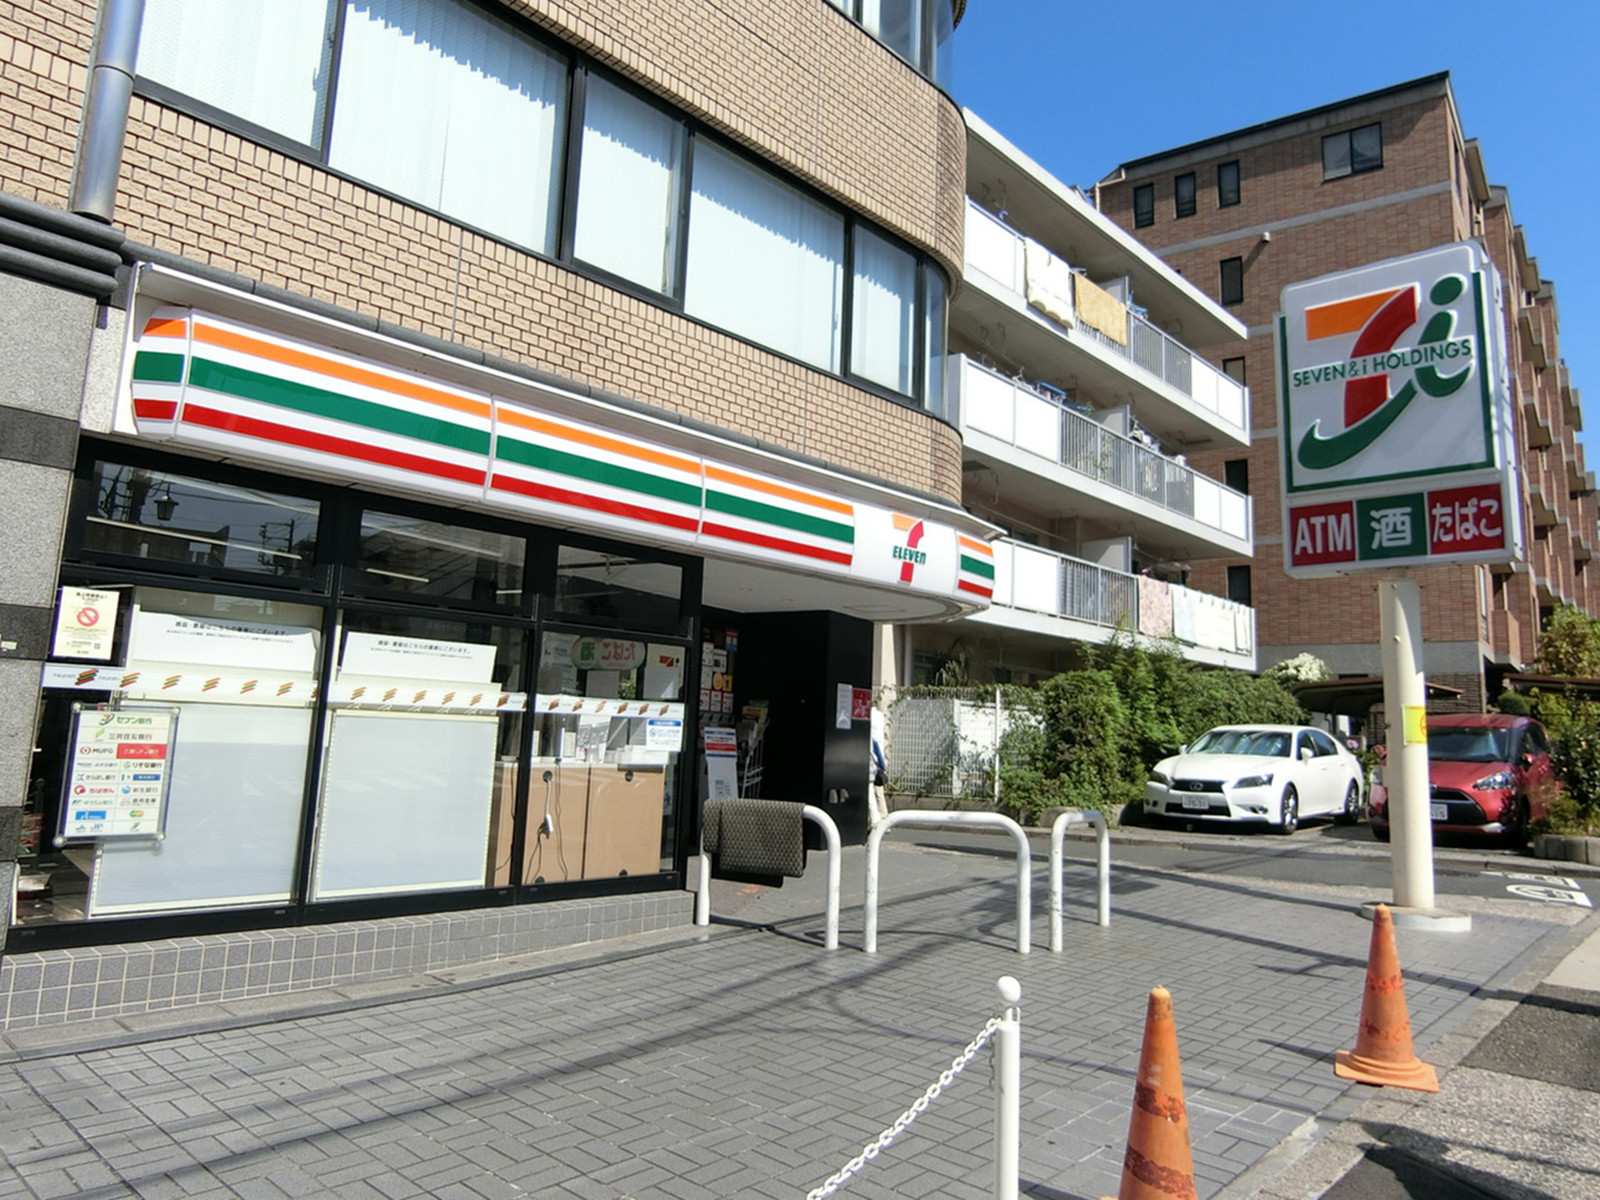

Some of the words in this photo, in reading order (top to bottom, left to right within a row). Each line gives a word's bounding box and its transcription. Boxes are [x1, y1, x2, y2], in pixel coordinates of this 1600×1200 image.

[1373, 340, 1472, 373] HOLDINGS
[1294, 512, 1353, 555] ATM
[1370, 506, 1413, 550] 酒
[1432, 497, 1502, 541] たばこ
